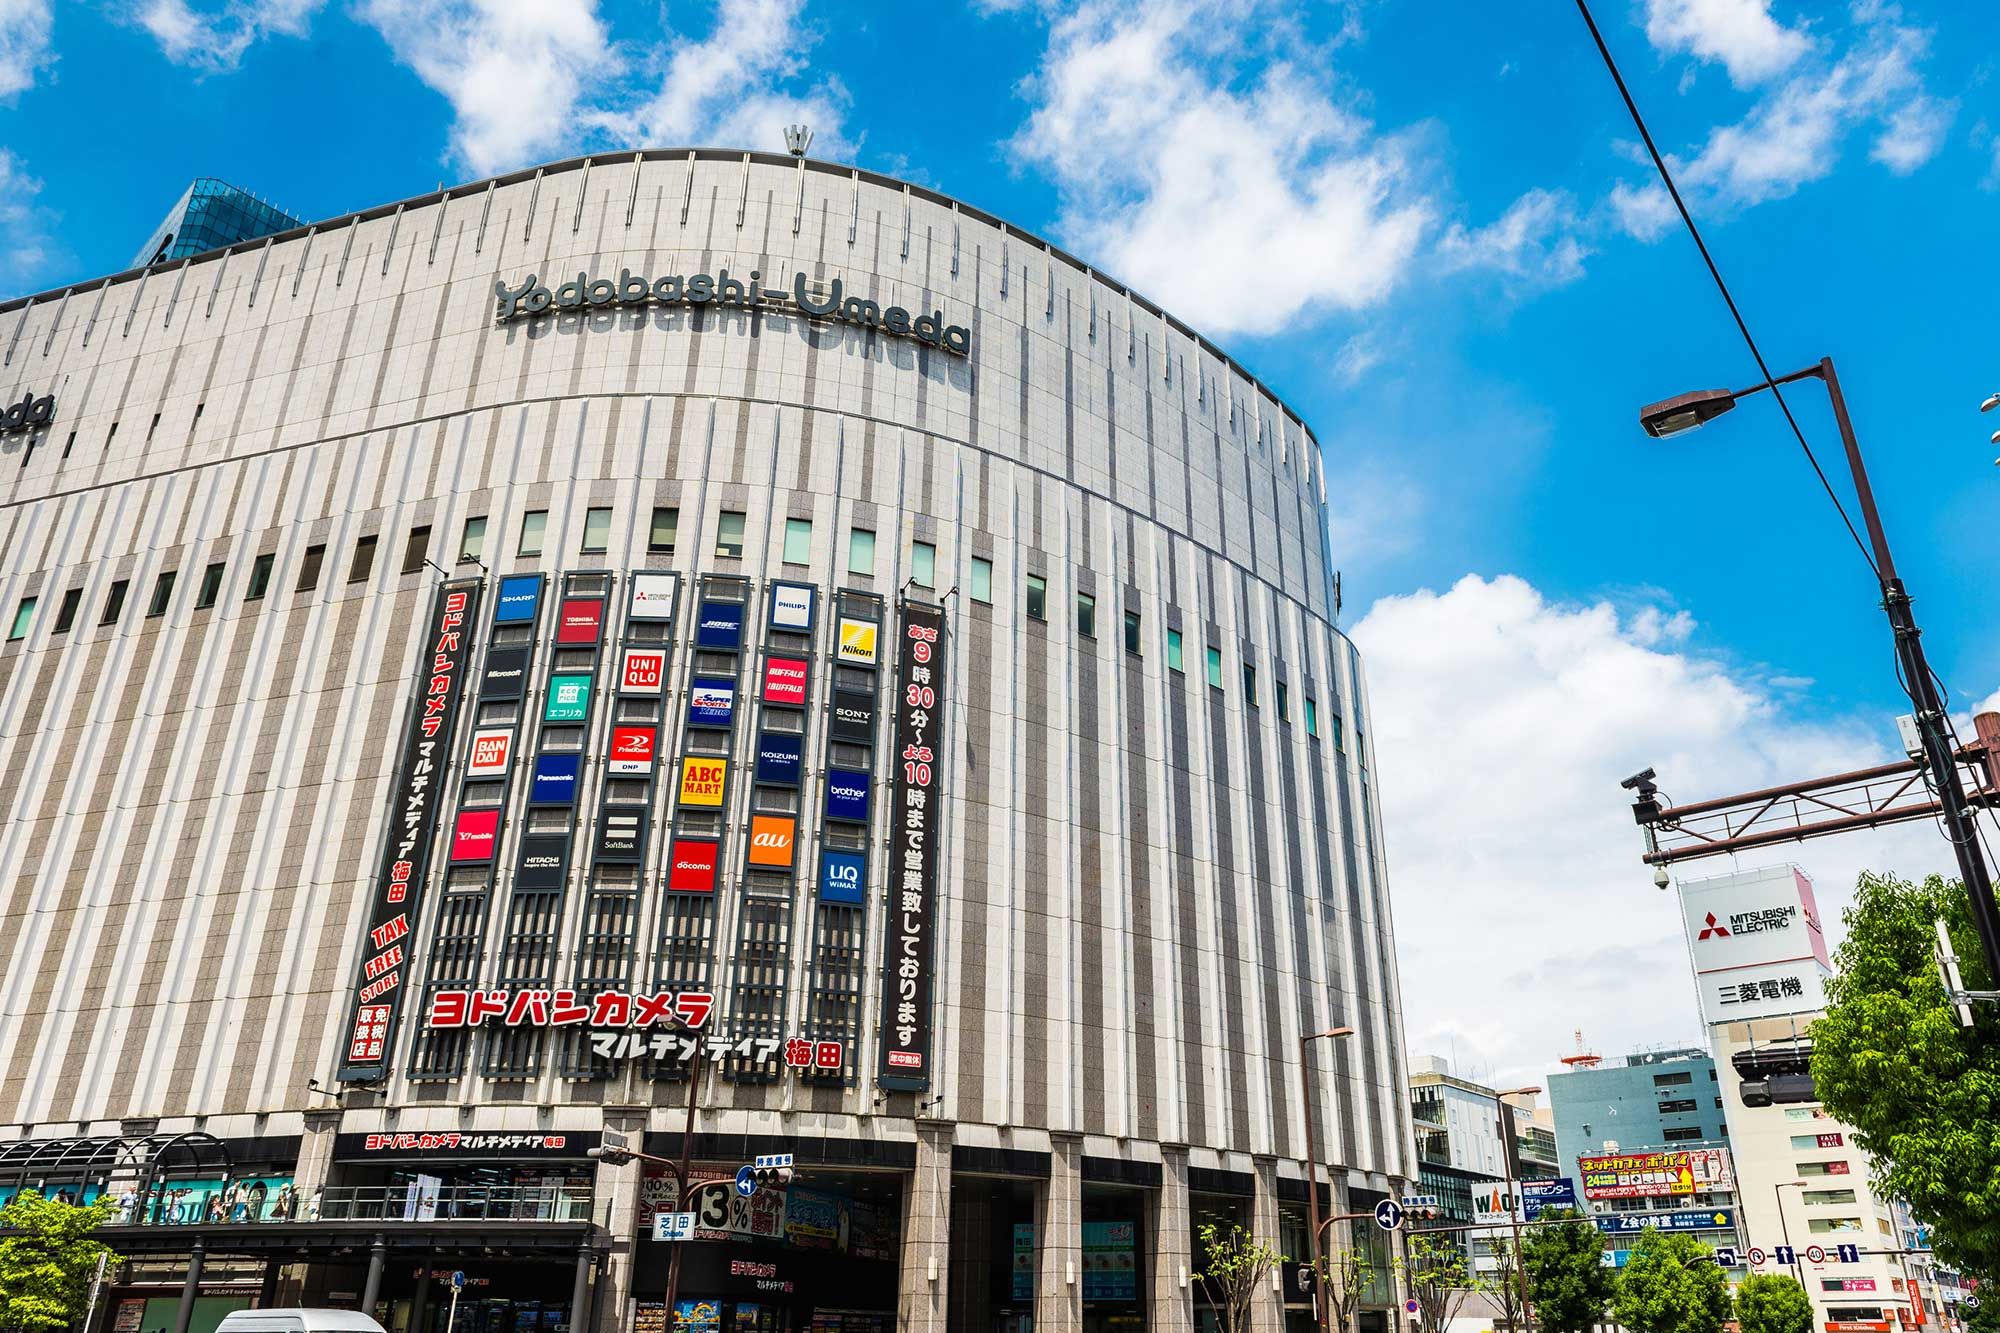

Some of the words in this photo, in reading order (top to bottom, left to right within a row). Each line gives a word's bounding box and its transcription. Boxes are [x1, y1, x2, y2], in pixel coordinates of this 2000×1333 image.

[496, 268, 971, 354] Yodobashi-Umeda
[0, 392, 55, 428] da
[502, 594, 535, 603] SHARP
[778, 602, 806, 610] PHILIPS
[842, 644, 872, 657] Nikon
[631, 659, 655, 670] UNI
[487, 669, 522, 678] Microsoft
[629, 672, 656, 683] QLO
[769, 668, 804, 679] BUFFALO
[693, 699, 728, 708] SPORTS
[549, 708, 583, 717] エコリカ
[836, 708, 871, 719] SONY
[478, 741, 506, 751] BAN
[475, 752, 497, 763] DAI
[761, 752, 799, 761] KOIZUMI
[537, 774, 574, 782] Panasonic
[686, 766, 723, 783] ABC
[684, 782, 721, 795] MART
[831, 785, 866, 798] brother
[754, 832, 791, 848] au
[527, 856, 560, 864] HITACHI
[677, 861, 711, 870] docomo
[830, 864, 858, 882] UQ
[829, 881, 857, 889] WiMAX
[1730, 905, 1796, 924] MITSUBISHI
[371, 913, 409, 949] TAX
[1732, 918, 1790, 935] ELECTRIC
[364, 945, 403, 980] FREE
[360, 970, 400, 1003] STORE
[1718, 976, 1803, 1005] 三菱電機
[429, 990, 715, 1029] ヨドバシカメラ
[367, 1007, 388, 1057] 免税品
[1583, 1159, 1643, 1171] ネットカフェ
[1646, 1154, 1689, 1169] ポパイ
[1586, 1174, 1600, 1187] 24
[1475, 1186, 1520, 1213] WAO!
[660, 1216, 689, 1229] 芝田
[1620, 1215, 1672, 1229] Z会の教室
[663, 1230, 684, 1238] Shibata
[1810, 1250, 1821, 1259] 40
[731, 1260, 777, 1278] ヨドバシカメラ
